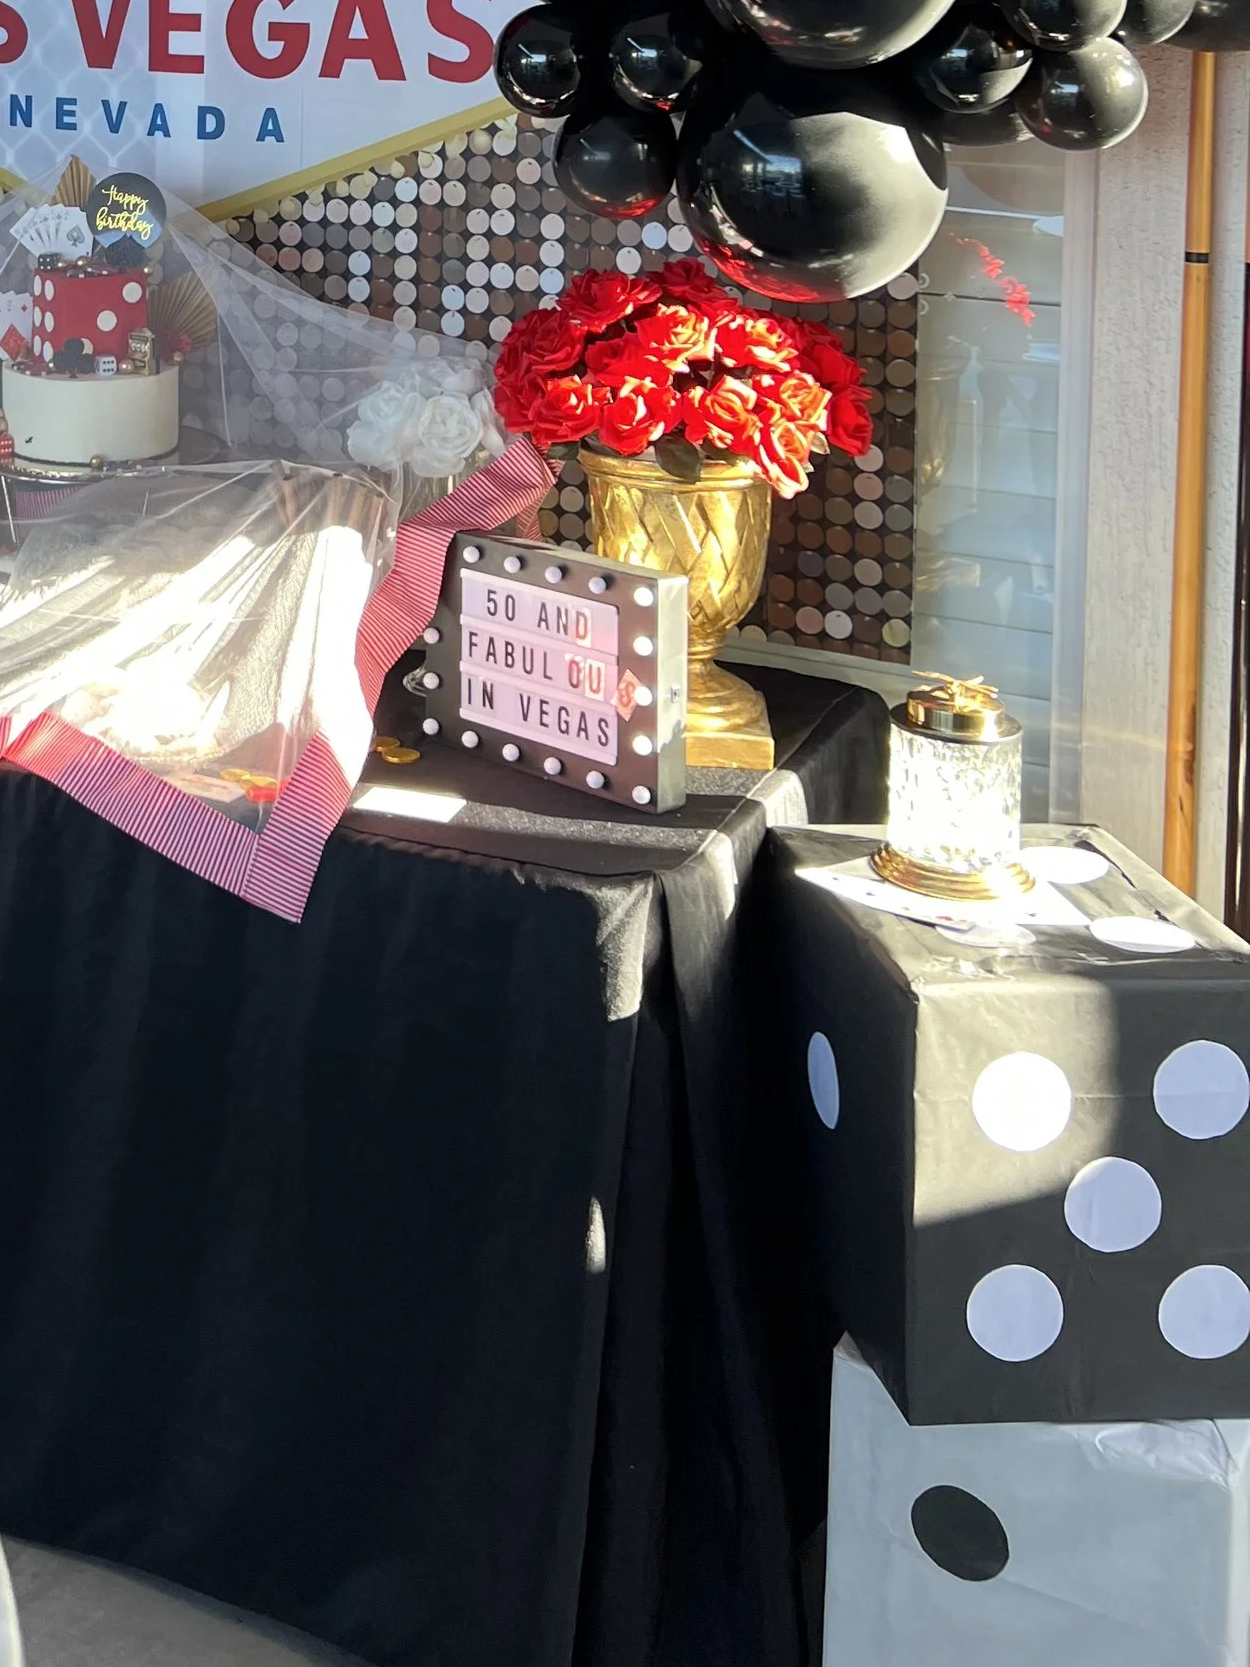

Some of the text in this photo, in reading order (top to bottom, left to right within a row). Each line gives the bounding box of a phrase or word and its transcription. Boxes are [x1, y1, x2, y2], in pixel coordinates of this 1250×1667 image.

[9, 94, 285, 143] NEVADA
[96, 206, 154, 240] birthday
[101, 184, 149, 215] Happy
[486, 589, 589, 641] 50 AND
[467, 678, 610, 747] IN VEGAS
